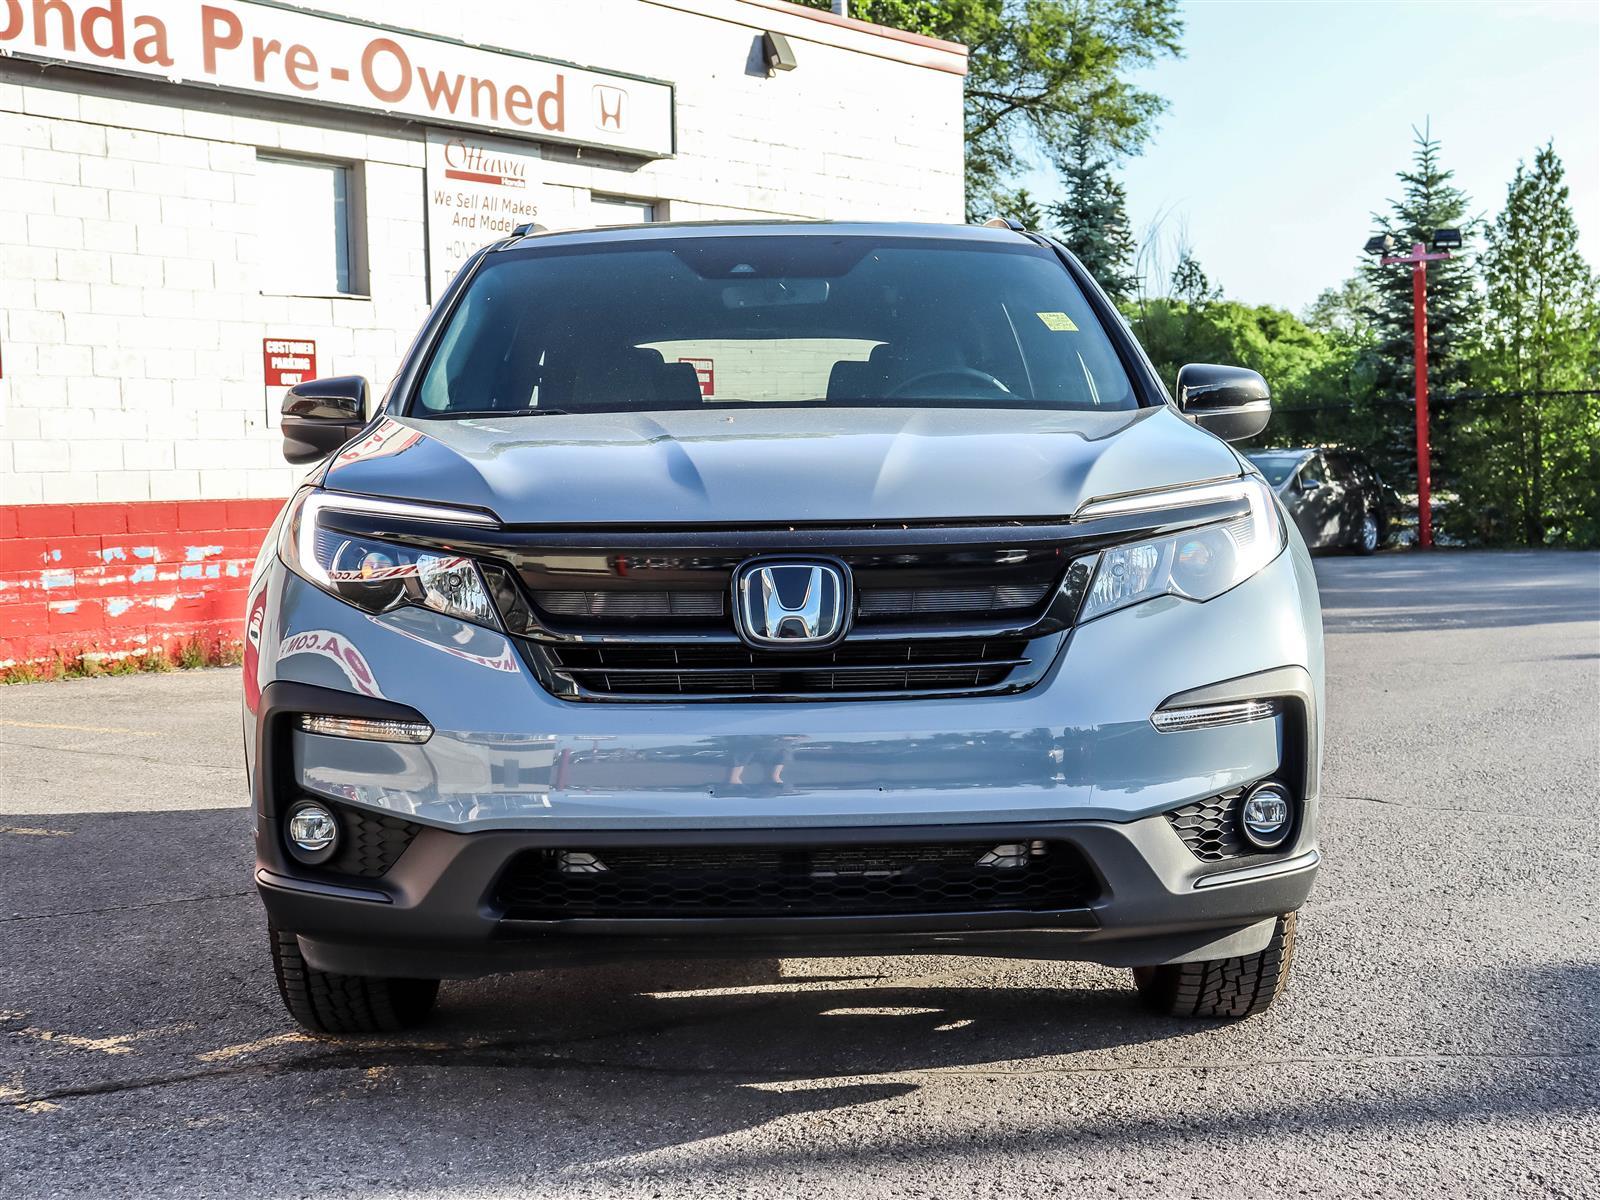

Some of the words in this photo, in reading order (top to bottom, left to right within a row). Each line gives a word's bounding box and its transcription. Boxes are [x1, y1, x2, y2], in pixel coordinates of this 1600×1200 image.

[201, 5, 564, 132] Pre-Owned
[434, 190, 452, 206] We
[456, 193, 478, 208] Sell
[482, 196, 498, 211] All
[502, 199, 538, 216] Makes
[453, 212, 476, 229] And
[266, 340, 314, 355] CUSTOMER
[271, 356, 310, 370] PARKING
